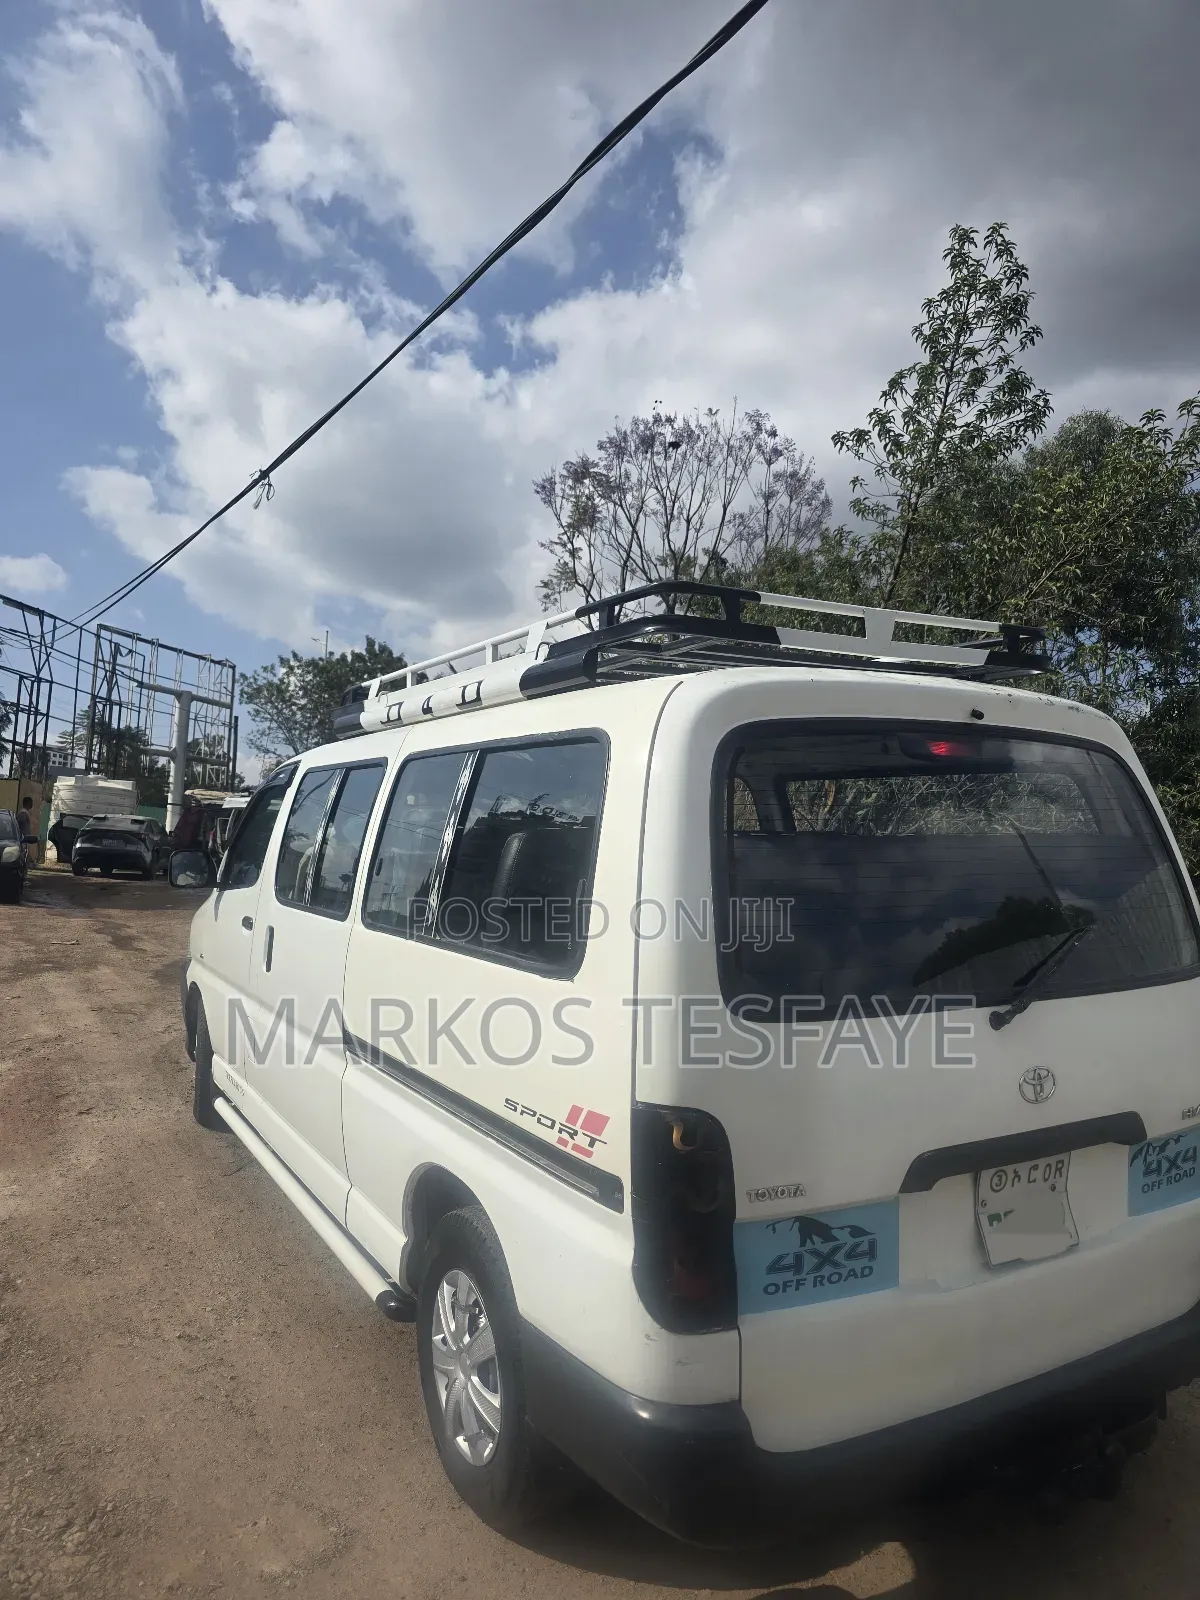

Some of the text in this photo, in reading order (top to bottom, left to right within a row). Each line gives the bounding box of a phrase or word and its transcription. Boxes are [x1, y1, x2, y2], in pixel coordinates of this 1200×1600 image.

[503, 1097, 608, 1149] SPORT
[746, 1183, 806, 1203] TOYOTA
[1141, 1166, 1196, 1194] OFF ROAD
[762, 1265, 875, 1296] OFF ROAD
